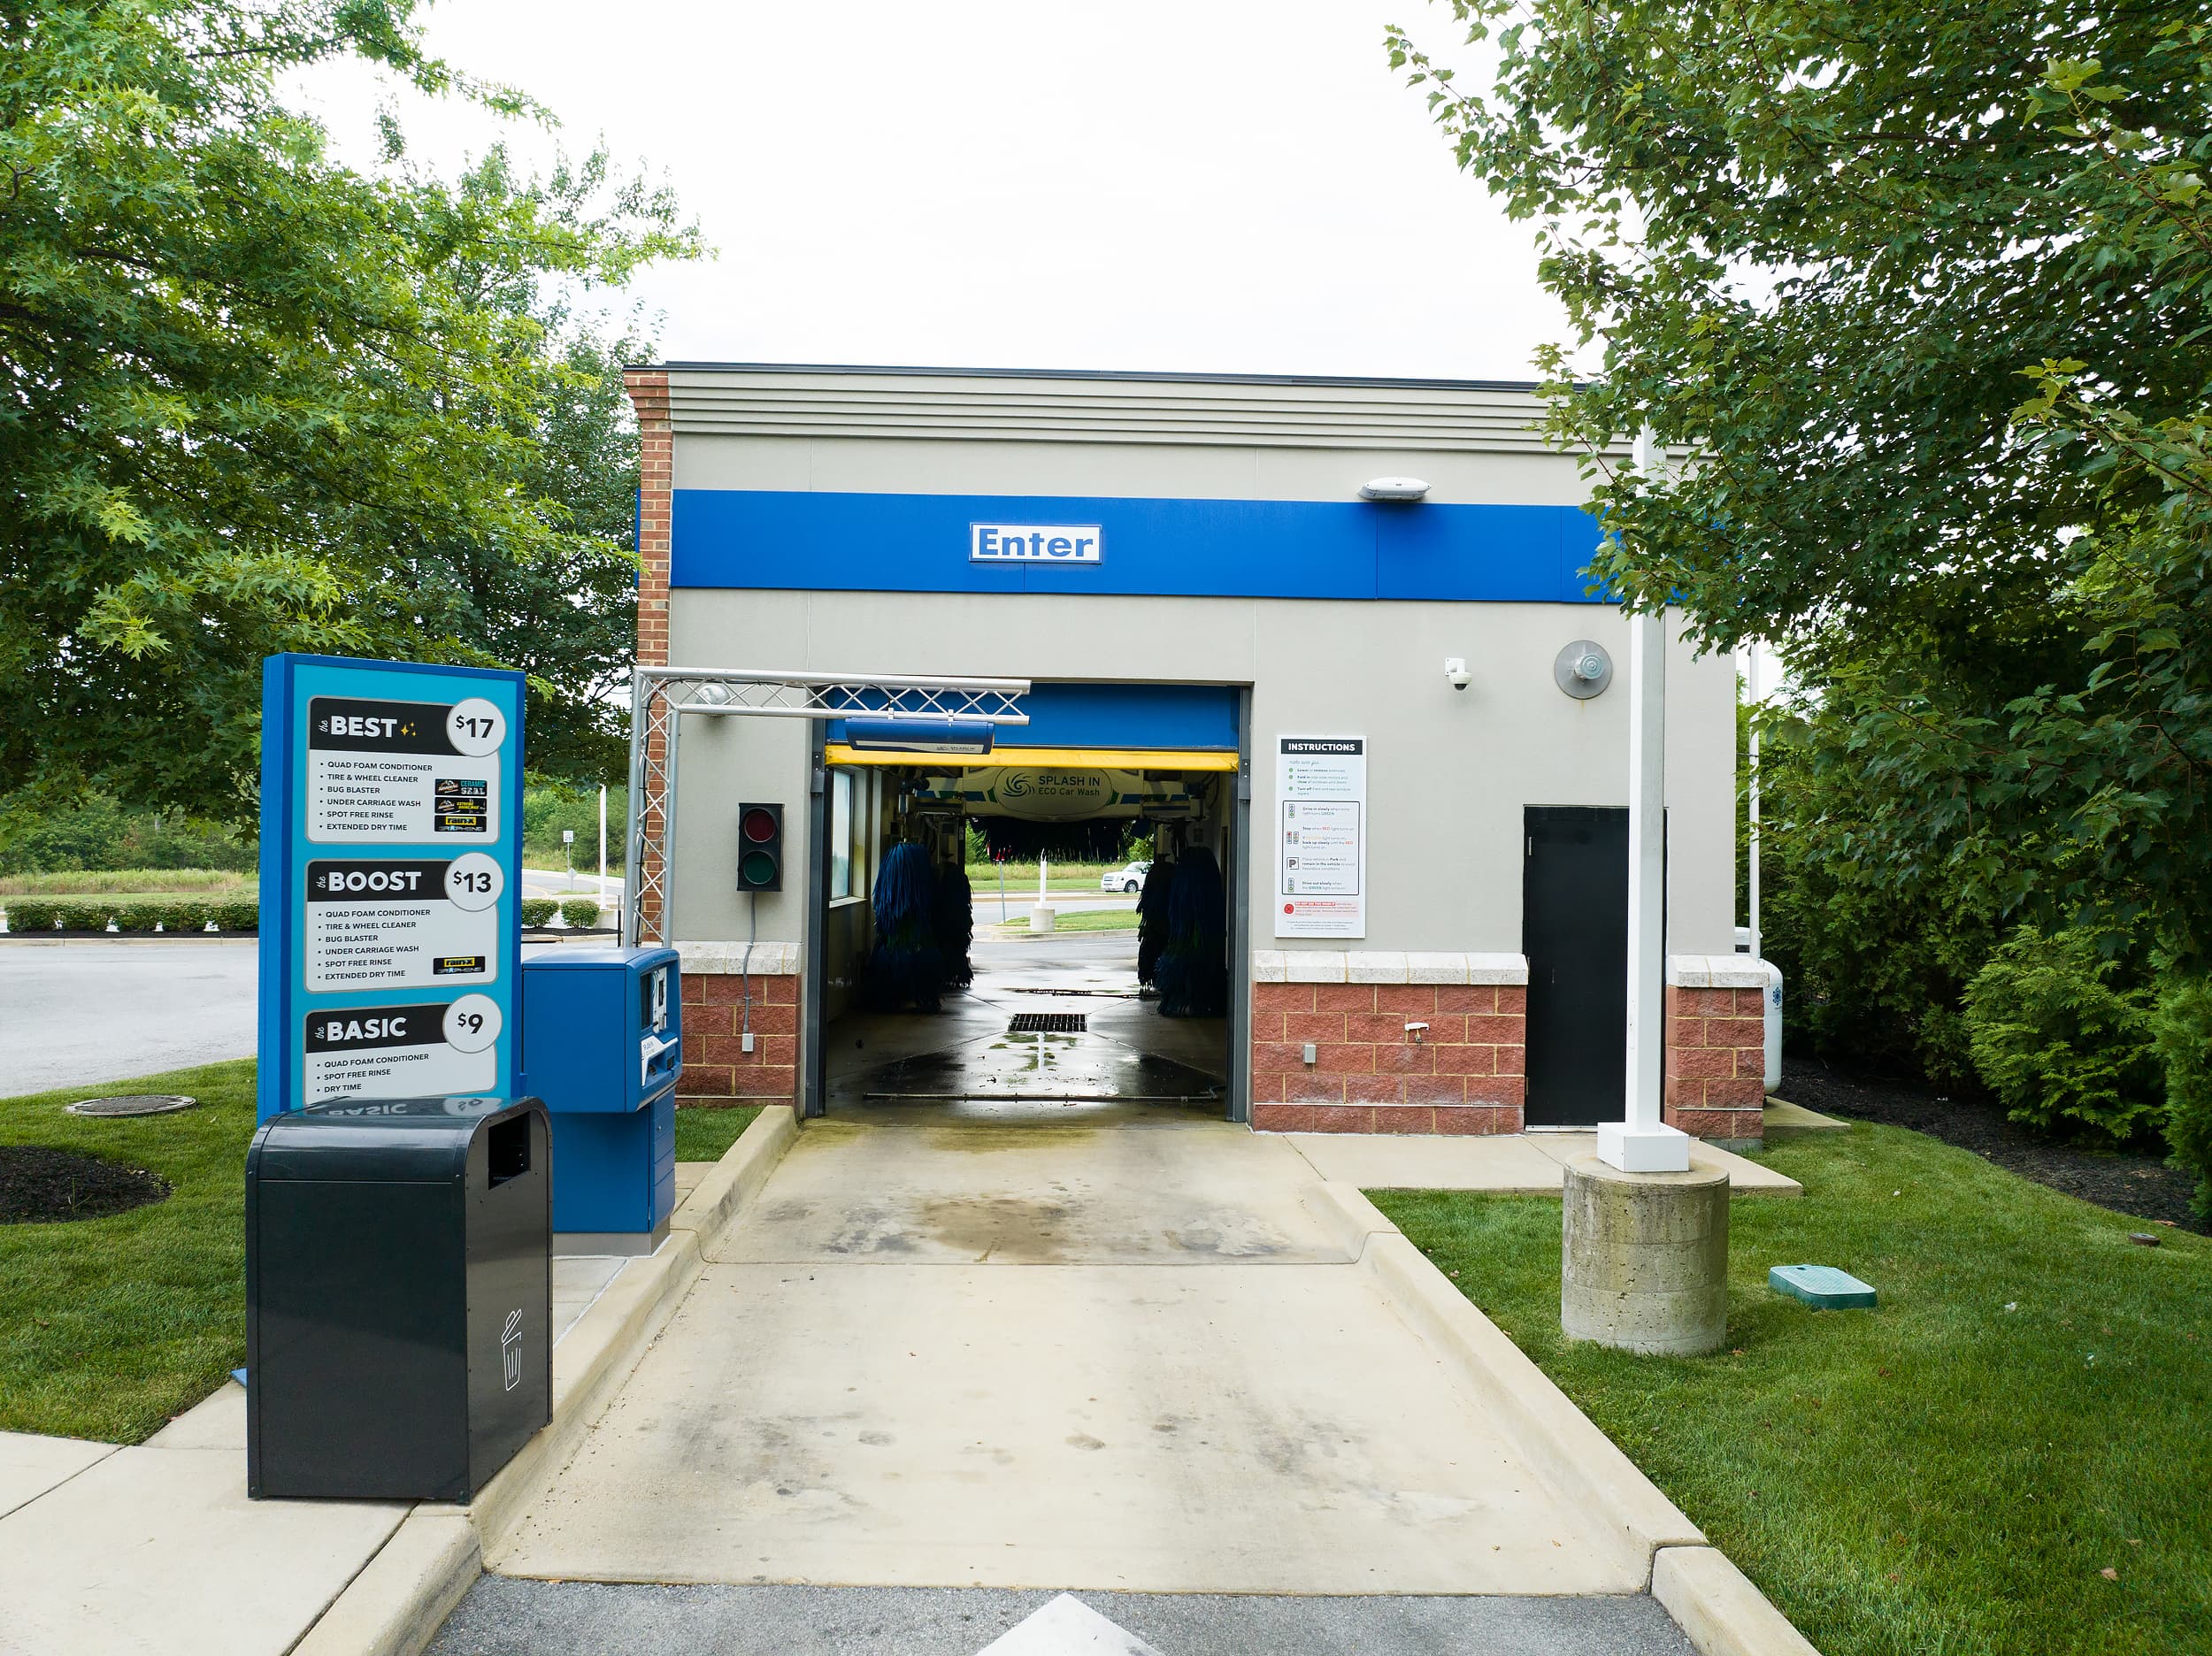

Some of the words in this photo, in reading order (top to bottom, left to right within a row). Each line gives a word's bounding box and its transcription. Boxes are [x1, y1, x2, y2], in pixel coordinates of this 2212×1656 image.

[979, 528, 1094, 557] Enter
[319, 719, 328, 732] the
[330, 716, 397, 738] BEST
[455, 715, 494, 739] $17
[380, 763, 433, 771] CONDITIONER
[1039, 776, 1085, 786] SPLASH
[317, 877, 326, 888] the
[328, 871, 422, 892] BOOST
[453, 870, 491, 893] $13
[315, 1026, 325, 1039] the
[326, 1017, 407, 1041] BASIC
[457, 1013, 483, 1034] $9
[376, 1054, 429, 1064] CONDITIONER
